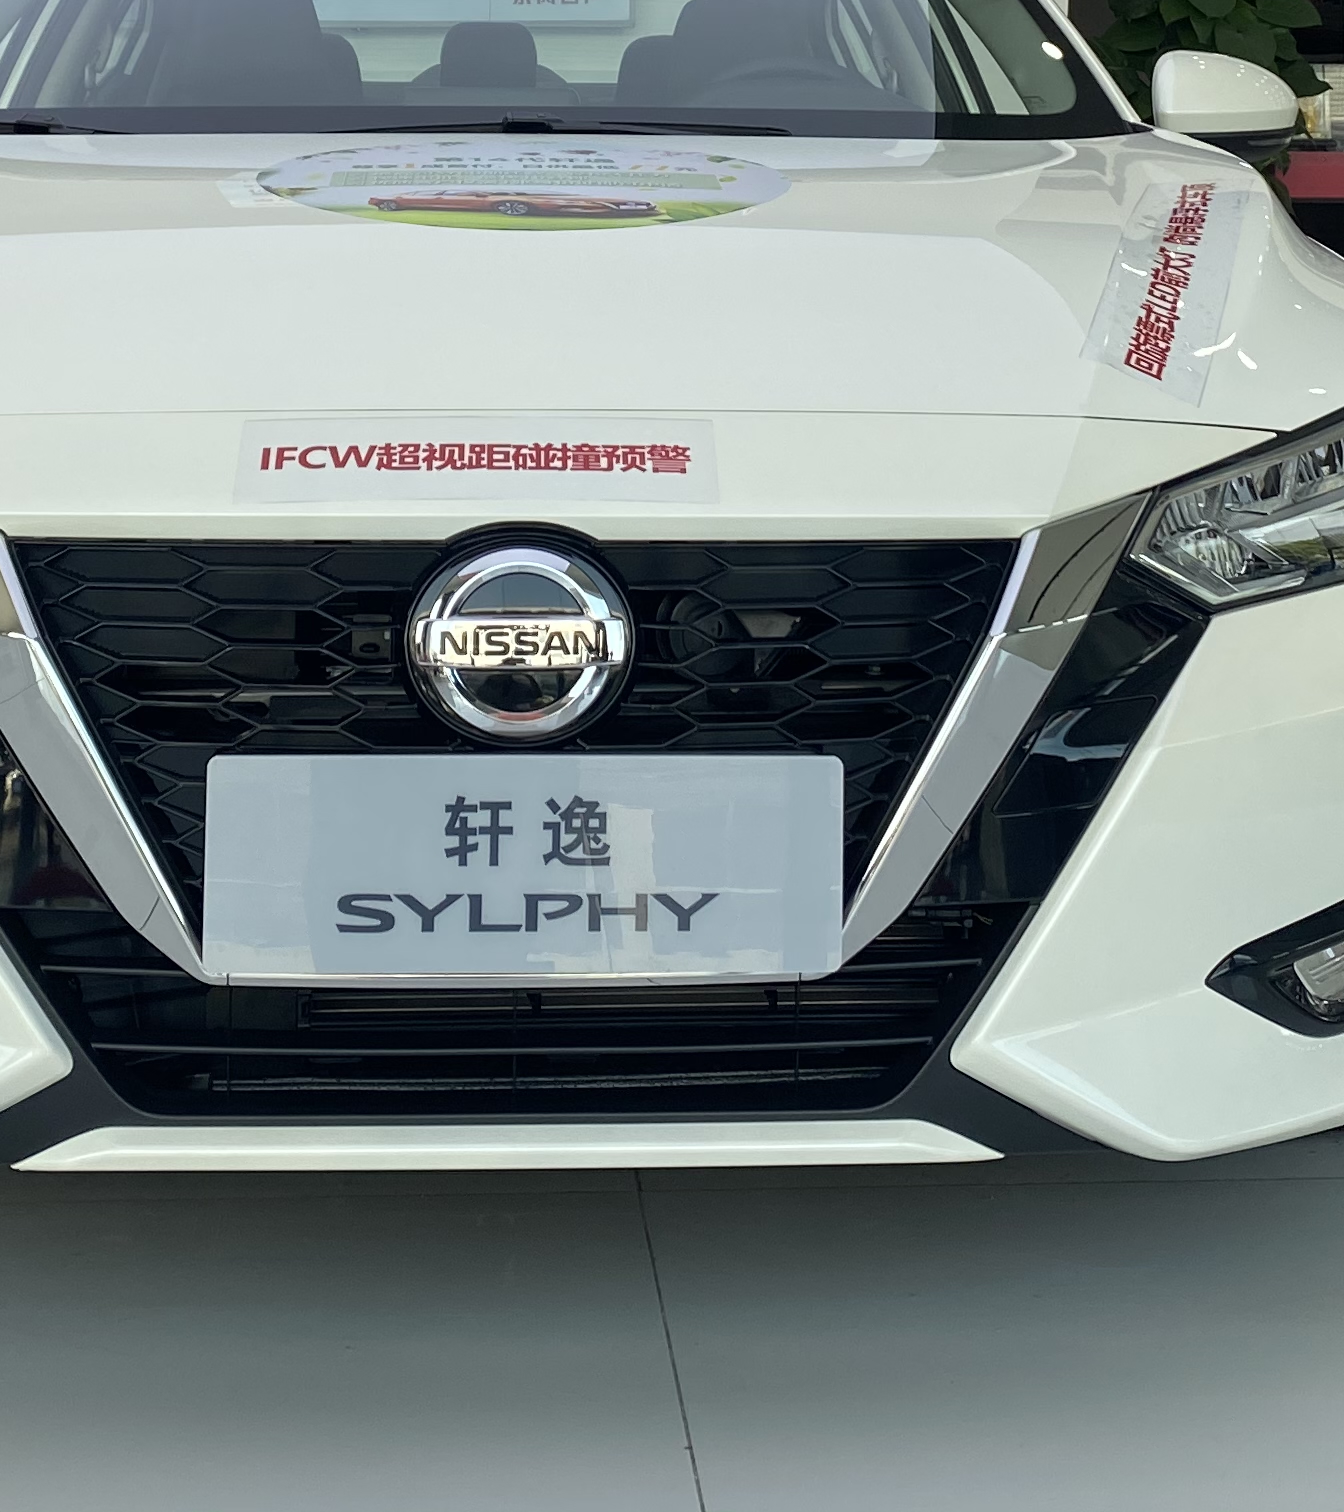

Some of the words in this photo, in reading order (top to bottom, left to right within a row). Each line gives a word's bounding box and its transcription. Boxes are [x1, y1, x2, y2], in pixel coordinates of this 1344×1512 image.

[259, 442, 692, 474] IFCW超视距碰撞预警
[439, 628, 608, 659] NISSAN
[444, 794, 611, 868] 轩逸
[335, 892, 720, 934] SYLPHY
